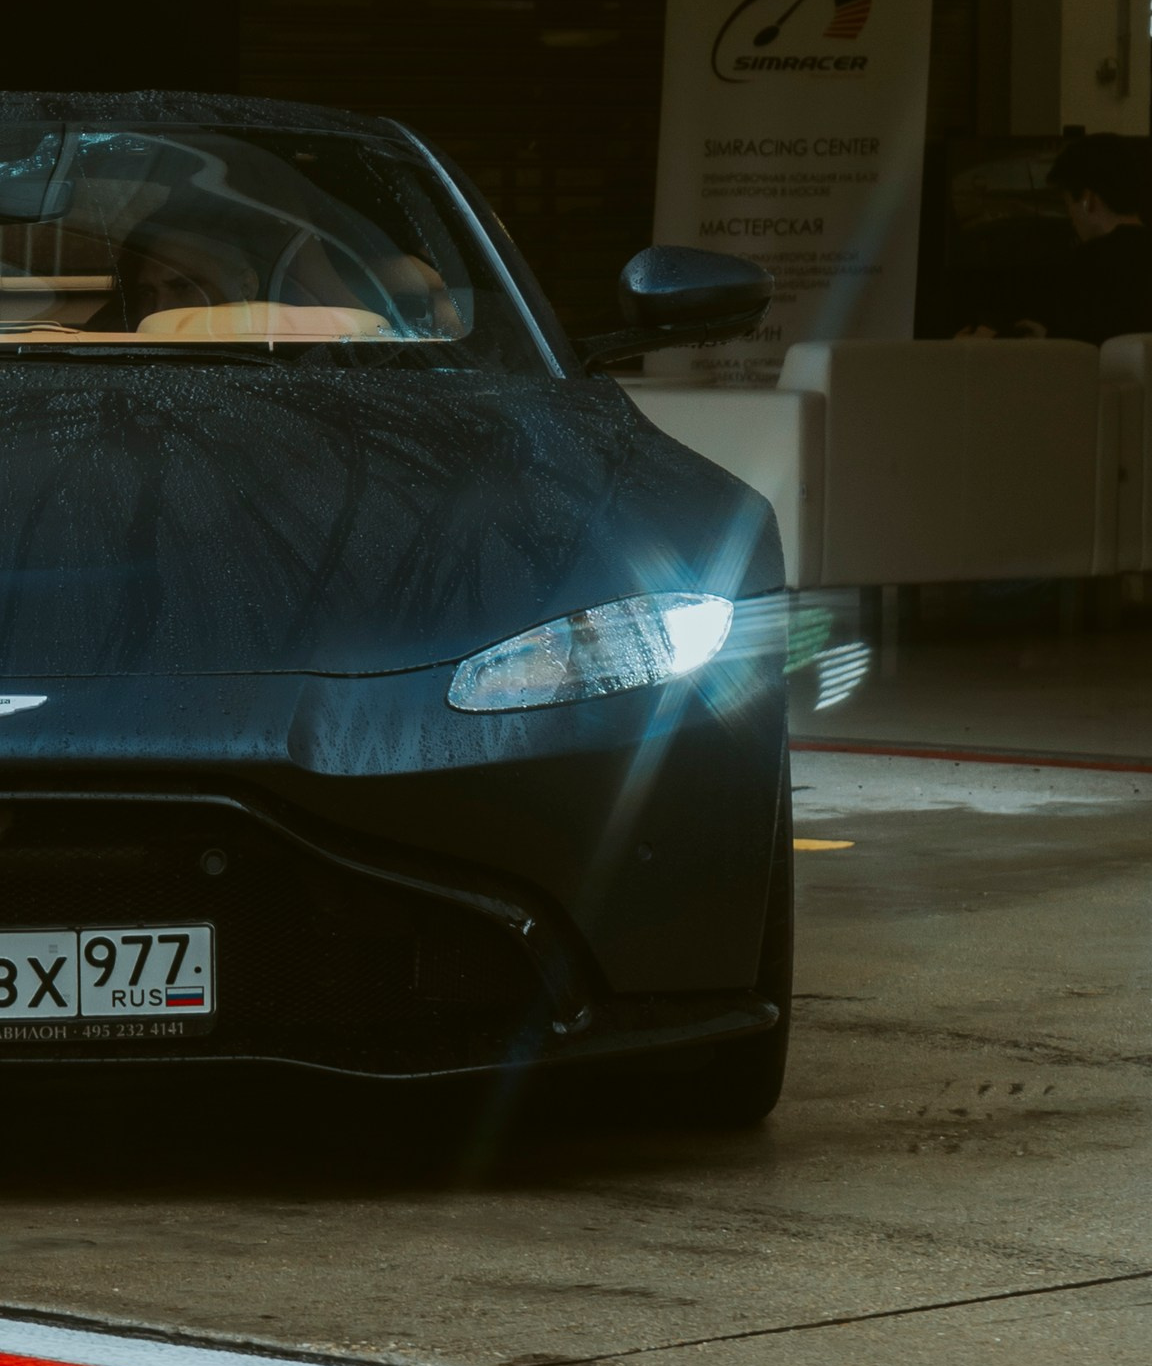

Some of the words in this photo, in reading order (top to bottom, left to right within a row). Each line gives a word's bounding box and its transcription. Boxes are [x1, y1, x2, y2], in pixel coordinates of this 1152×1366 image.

[733, 55, 869, 72] SIMRACER
[704, 139, 808, 157] SIMRACING
[813, 138, 880, 156] CENTER
[699, 218, 824, 237] МАСТЕРСКАЯ
[84, 934, 190, 988] 977
[112, 989, 163, 1007] RUS
[81, 1025, 110, 1039] 495
[117, 1024, 144, 1037] 232
[150, 1022, 184, 1036] 4141
